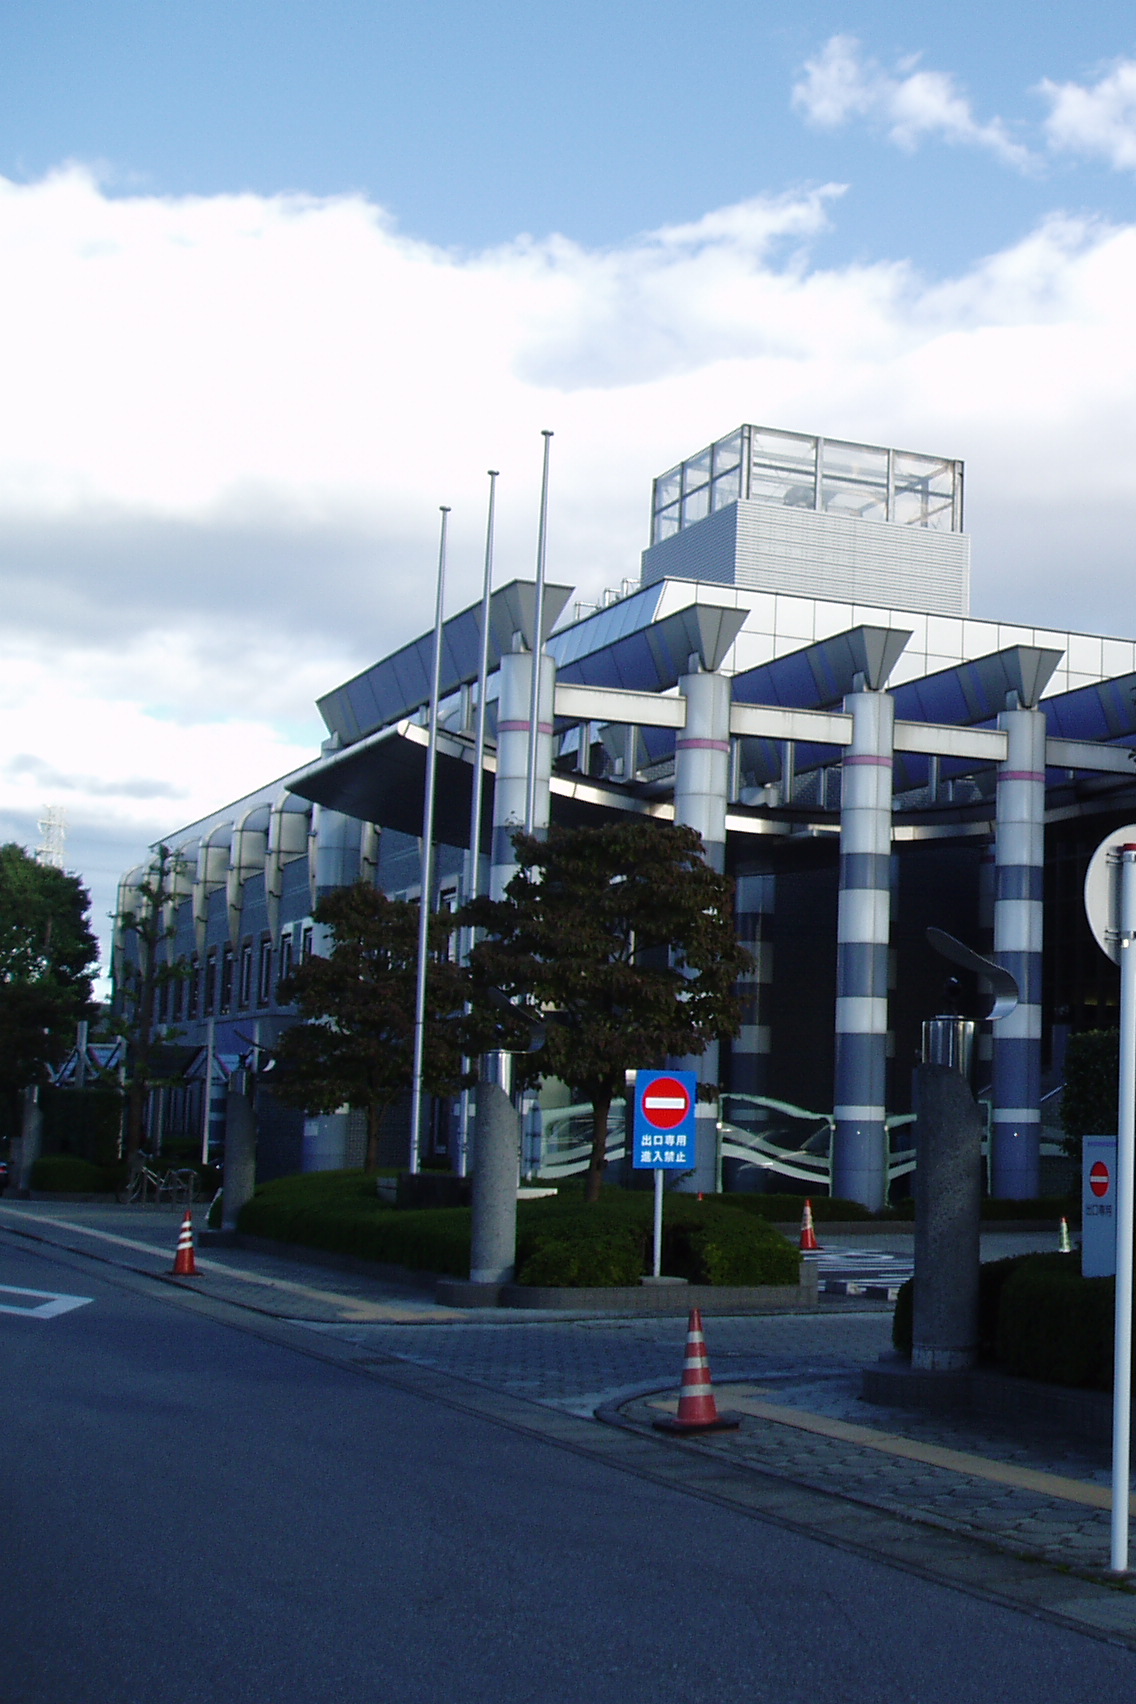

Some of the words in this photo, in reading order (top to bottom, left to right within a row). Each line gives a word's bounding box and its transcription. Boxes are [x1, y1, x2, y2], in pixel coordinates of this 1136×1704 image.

[641, 1134, 687, 1147] 出口専用
[640, 1151, 687, 1163] 進入禁止
